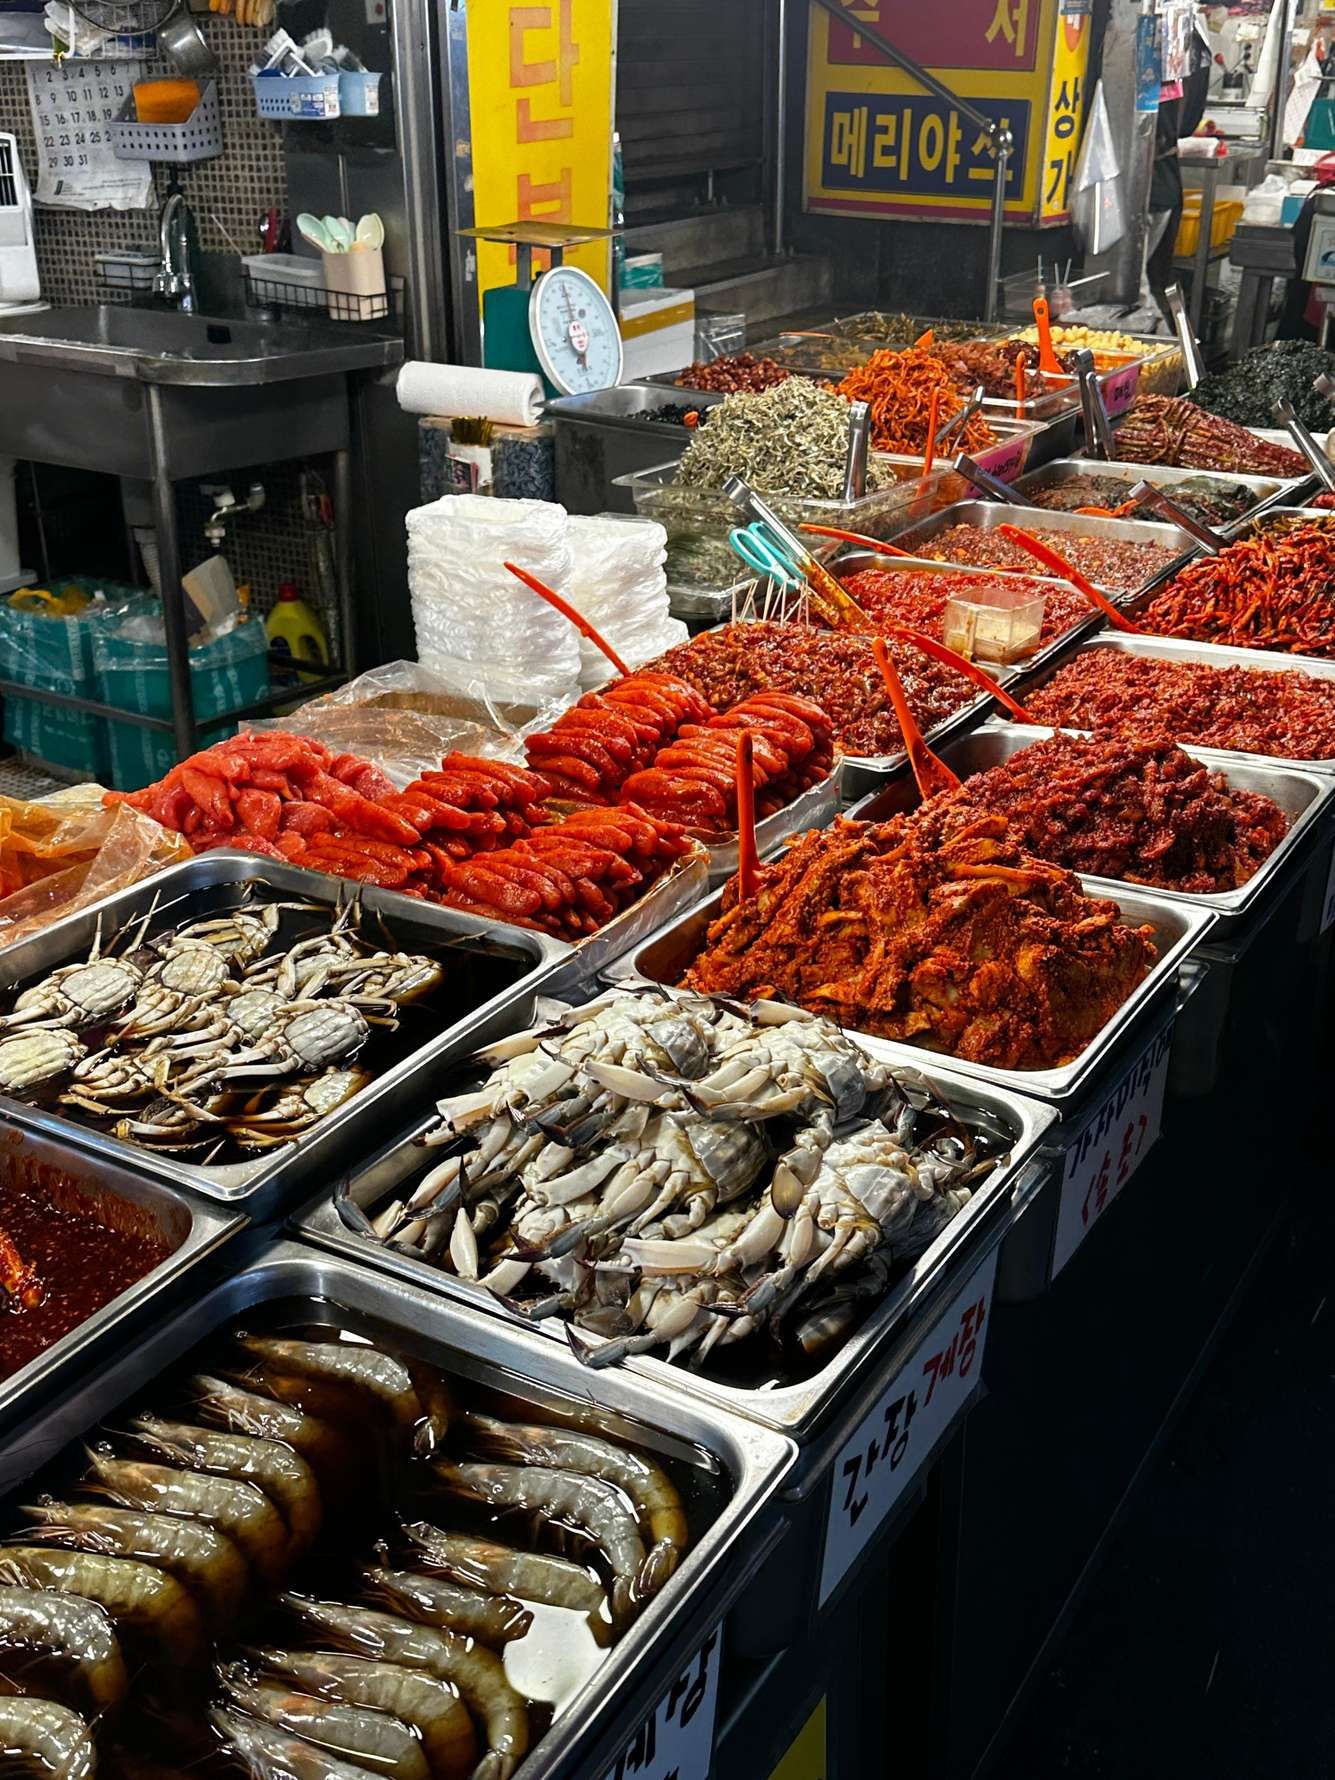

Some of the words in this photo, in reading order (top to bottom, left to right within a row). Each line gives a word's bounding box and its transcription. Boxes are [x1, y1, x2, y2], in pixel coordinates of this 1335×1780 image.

[46, 71, 53, 82] 2
[63, 70, 68, 81] 3
[79, 68, 85, 78] 4
[95, 66, 101, 76] 5
[110, 65, 116, 75] 6
[35, 94, 41, 105] 8
[50, 93, 56, 104] 9
[67, 91, 77, 102] 10
[83, 89, 92, 100] 11
[99, 87, 109, 98] 12
[114, 85, 124, 97] 13
[40, 115, 50, 126] 15
[55, 113, 66, 124] 16
[71, 112, 80, 123] 17
[86, 110, 96, 122] 18
[102, 108, 112, 120] 19
[44, 136, 54, 147] 22
[59, 134, 70, 146] 23
[75, 133, 85, 144] 24
[90, 131, 101, 142] 25
[48, 156, 58, 168] 29
[64, 155, 74, 166] 30
[78, 154, 88, 165] 31
